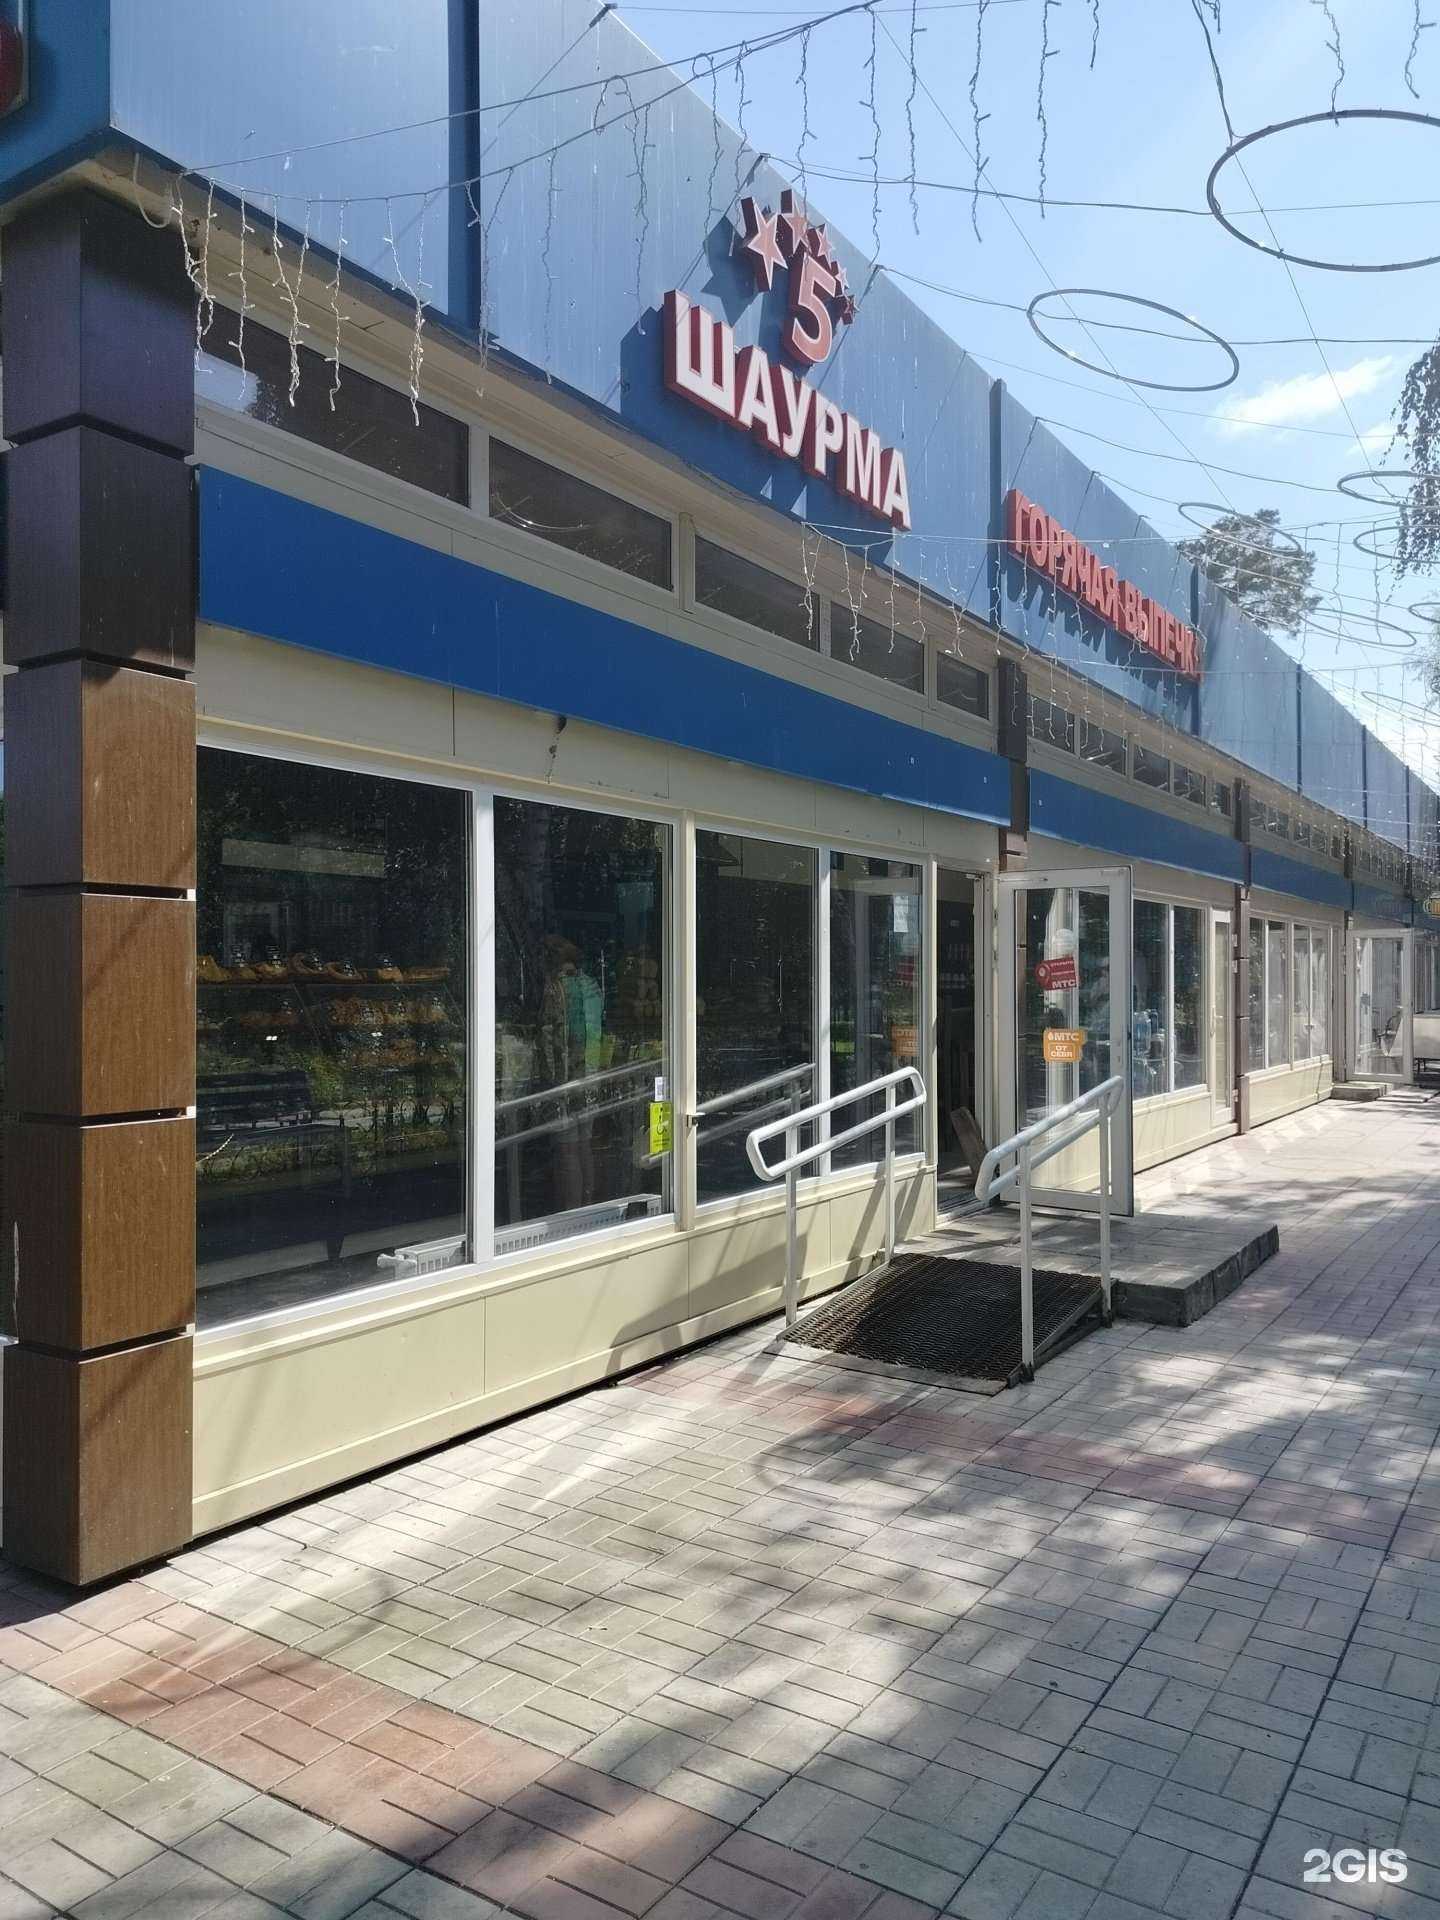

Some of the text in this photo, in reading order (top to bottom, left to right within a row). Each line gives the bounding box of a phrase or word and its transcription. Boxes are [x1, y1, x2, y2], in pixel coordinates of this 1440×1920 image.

[786, 252, 836, 363] 5
[665, 289, 912, 531] ШАУРМА
[1009, 488, 1121, 632] ГОРЯЧАЯ
